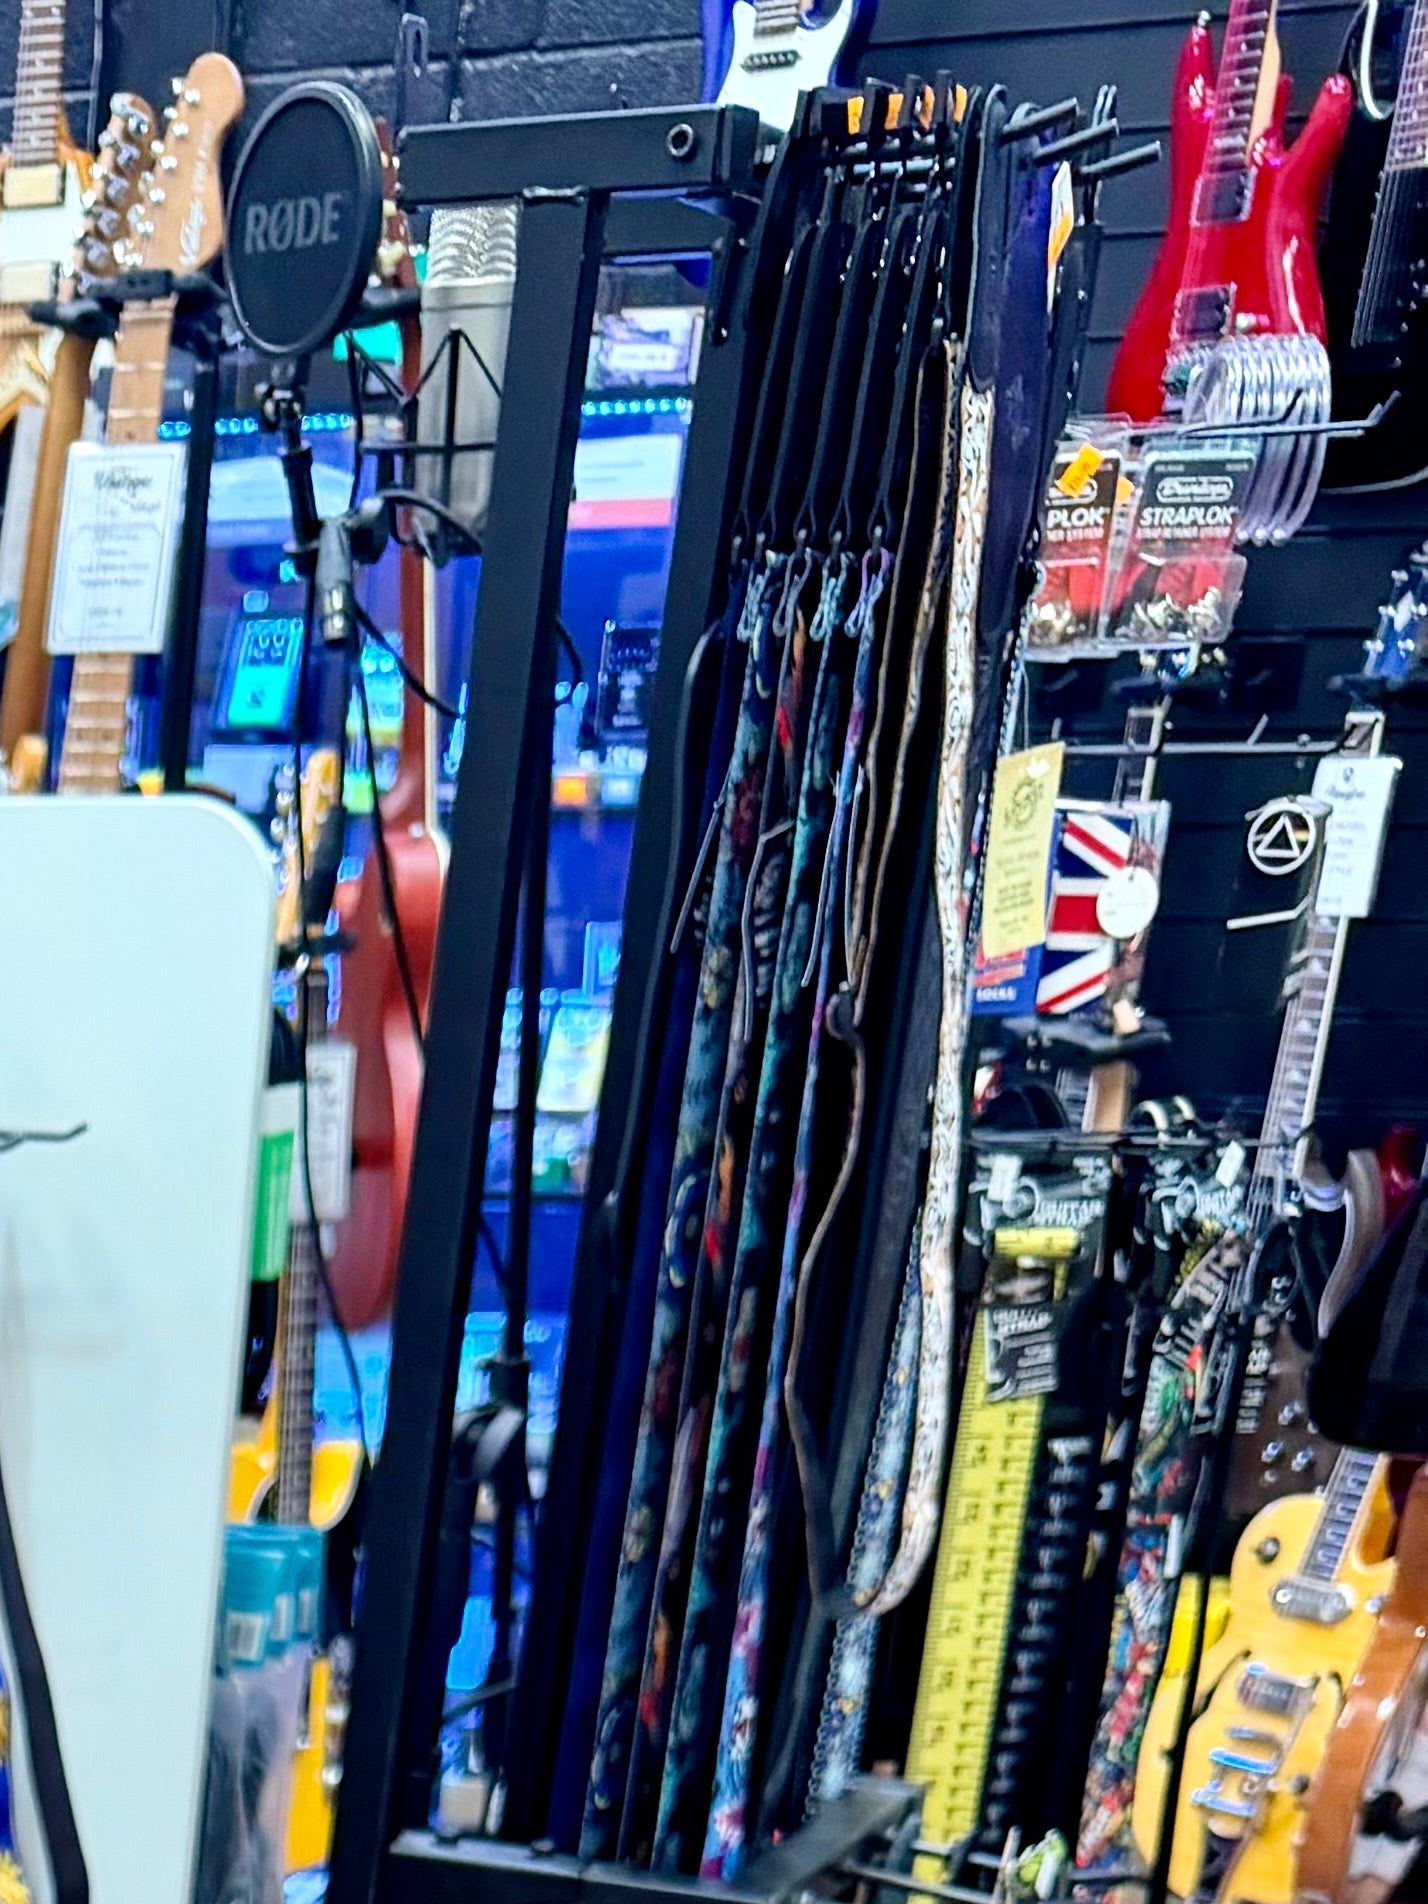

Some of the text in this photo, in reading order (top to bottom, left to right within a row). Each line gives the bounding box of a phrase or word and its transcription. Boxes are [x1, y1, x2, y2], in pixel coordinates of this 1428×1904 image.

[245, 191, 342, 254] RØDE
[1046, 507, 1106, 528] PLOK
[1140, 506, 1234, 526] STRAPLOK
